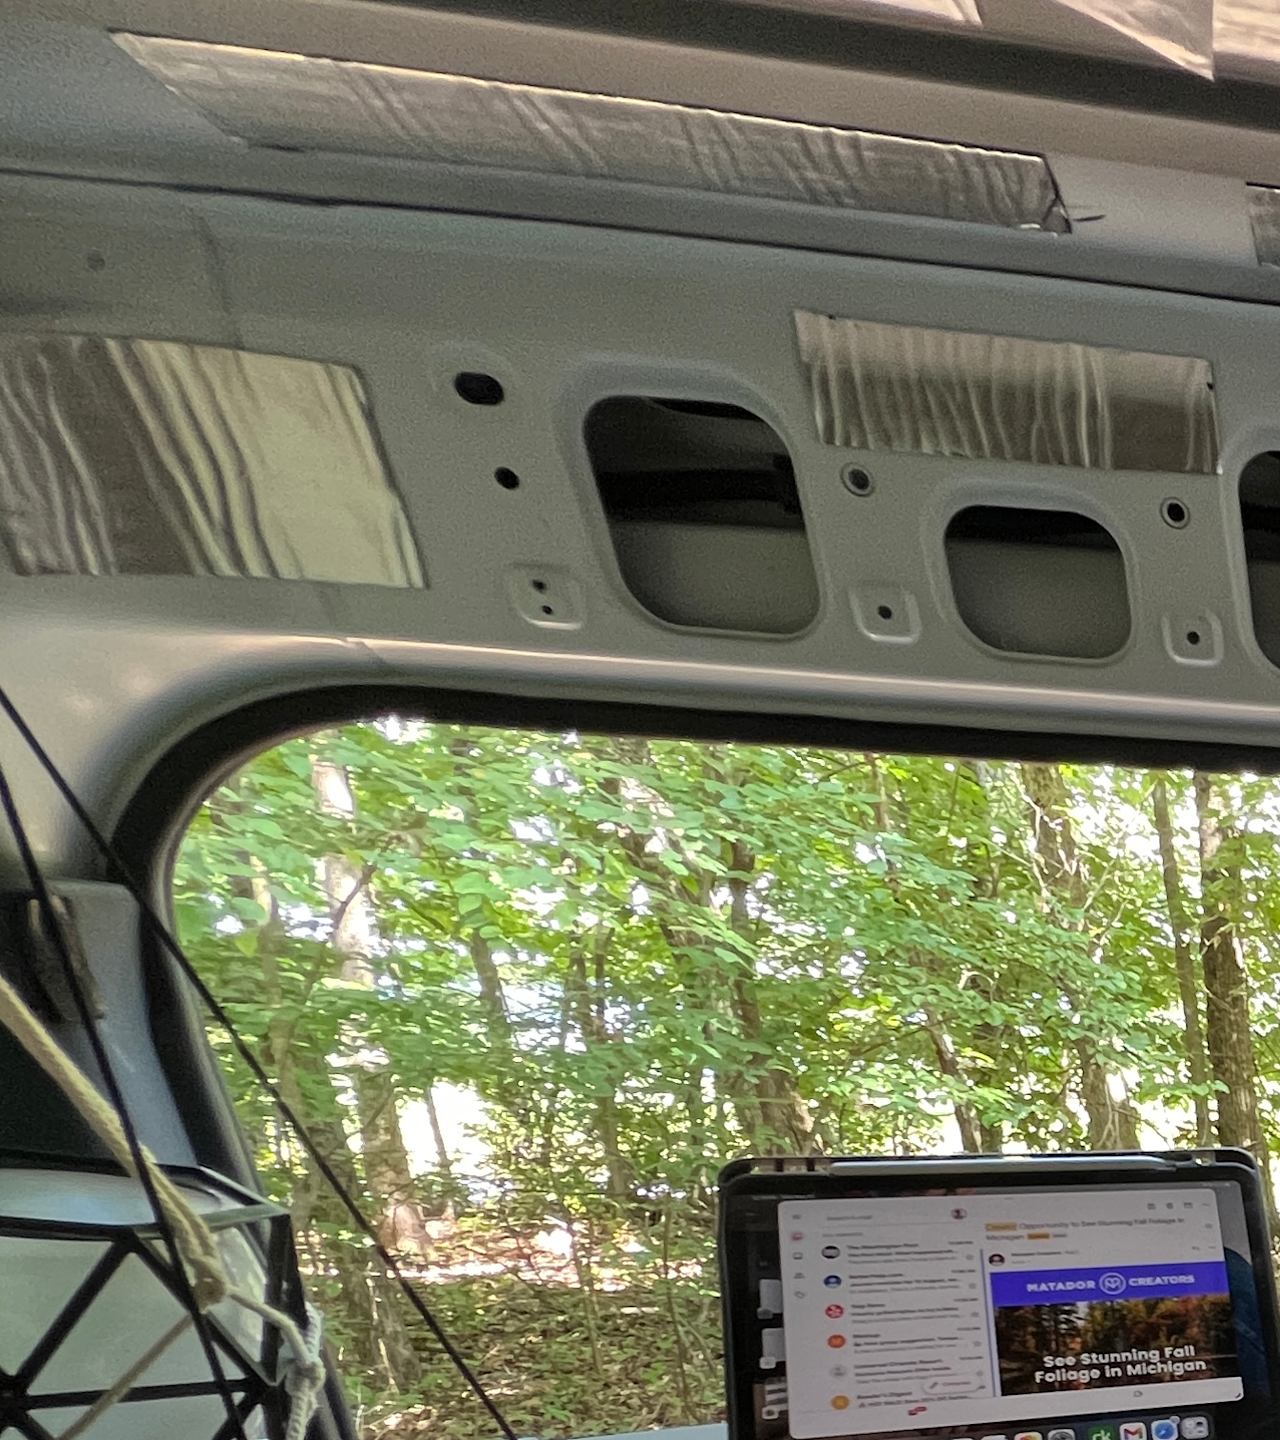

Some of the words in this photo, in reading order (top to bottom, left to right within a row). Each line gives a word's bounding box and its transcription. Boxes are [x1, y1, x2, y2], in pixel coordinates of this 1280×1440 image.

[1026, 1280, 1096, 1292] MATADOR
[1128, 1274, 1195, 1287] CREATORS
[1043, 1355, 1076, 1368] See
[1080, 1347, 1160, 1365] Stunning
[1164, 1345, 1196, 1358] Fall
[1034, 1365, 1100, 1384] Foliage
[1105, 1366, 1122, 1377] in
[1126, 1359, 1207, 1376] Michigan
